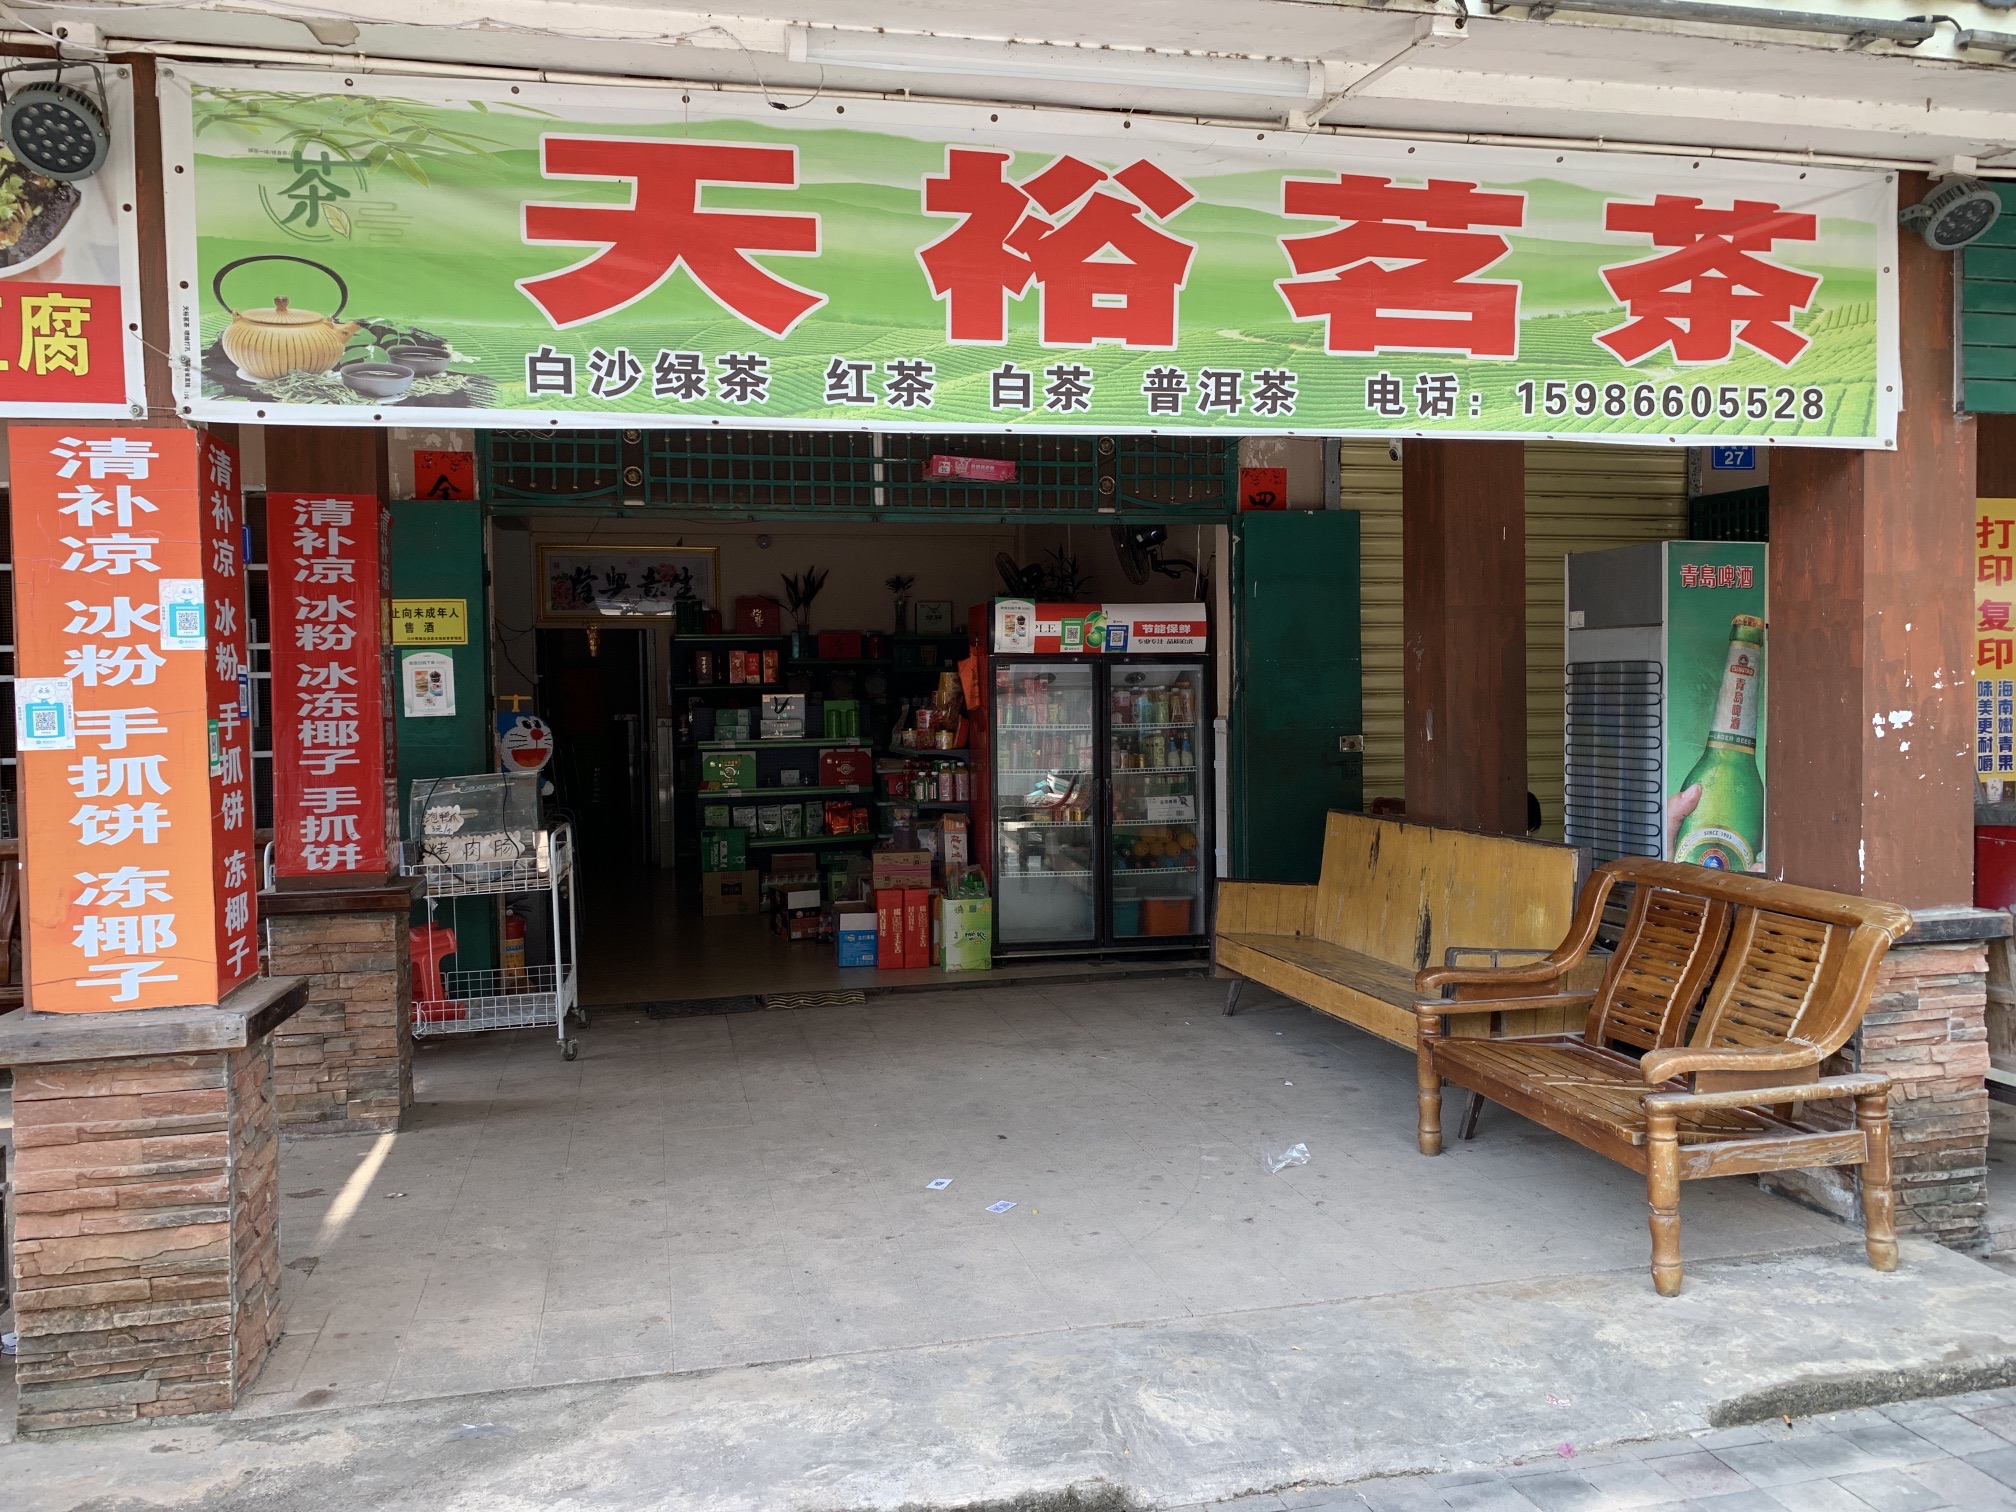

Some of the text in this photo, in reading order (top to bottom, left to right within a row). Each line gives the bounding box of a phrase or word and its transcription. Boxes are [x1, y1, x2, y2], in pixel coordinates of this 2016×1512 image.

[277, 151, 371, 228] 茶
[515, 132, 1823, 368] 天裕茗茶
[0, 292, 92, 376] 腐
[527, 347, 769, 404] 白沙绿茶
[826, 358, 934, 407] 红茶
[991, 364, 1092, 412] 白茶
[1143, 368, 1297, 416] 普洱茶
[1516, 380, 1825, 421] 15986605528
[1724, 451, 1744, 465] 27
[1142, 624, 1191, 634] 节能保鲜
[50, 436, 179, 1003] 清补凉 冰粉 手抓饼 冻椰子
[207, 443, 251, 979] 清补凉 冰粉 手抓饼 冻椰子
[293, 499, 365, 871] 清补凉 冰粉 冰冻椰子 手抓饼
